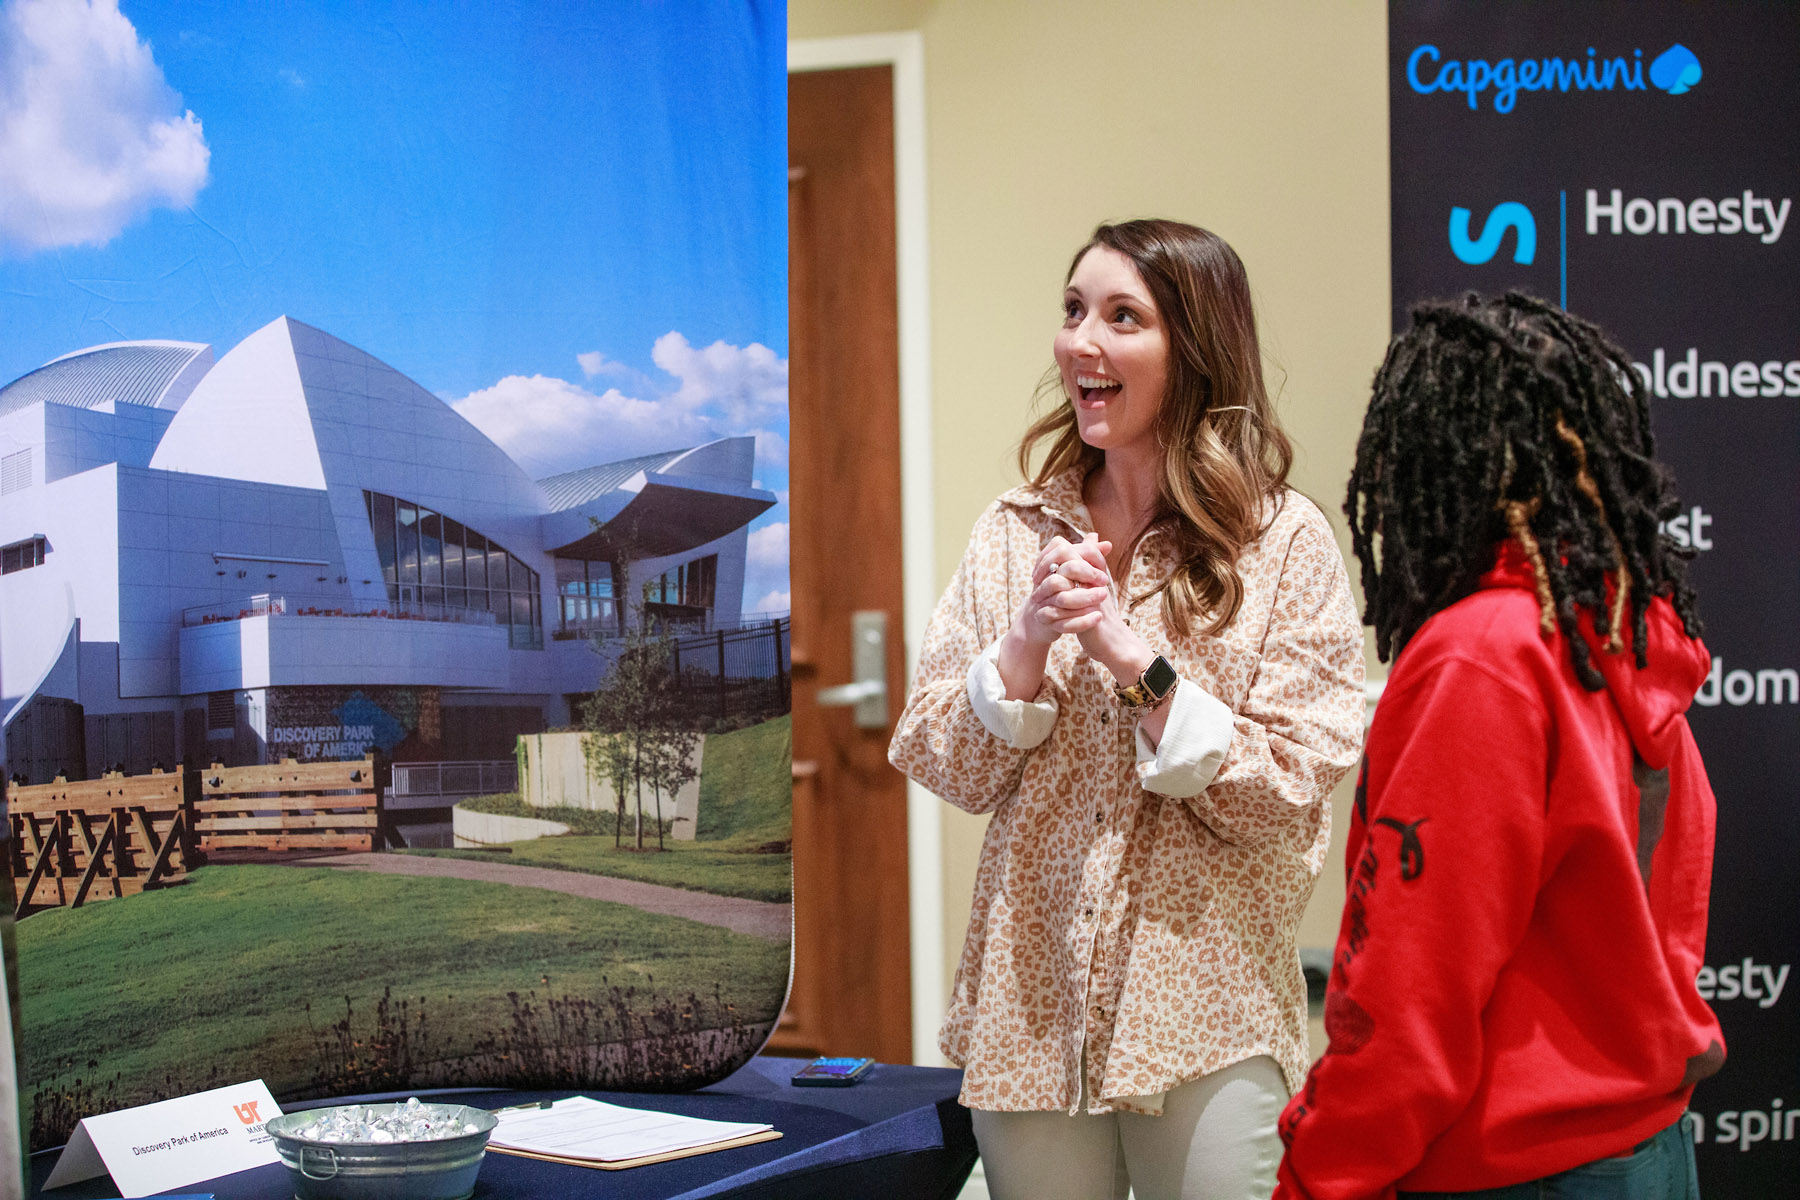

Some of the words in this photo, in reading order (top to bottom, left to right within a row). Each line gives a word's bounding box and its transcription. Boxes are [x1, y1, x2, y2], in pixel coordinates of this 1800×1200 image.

[1406, 44, 1648, 114] Capgemini
[1585, 188, 1792, 244] Honesty
[1605, 348, 1800, 399] oldness
[273, 726, 342, 743] DISCOVERY
[343, 725, 375, 741] PARK
[304, 743, 321, 759] OF
[232, 1100, 262, 1125] UT
[132, 1141, 172, 1156] Discovery
[170, 1135, 190, 1147] Park
[189, 1132, 199, 1142] of
[198, 1127, 229, 1140] America
